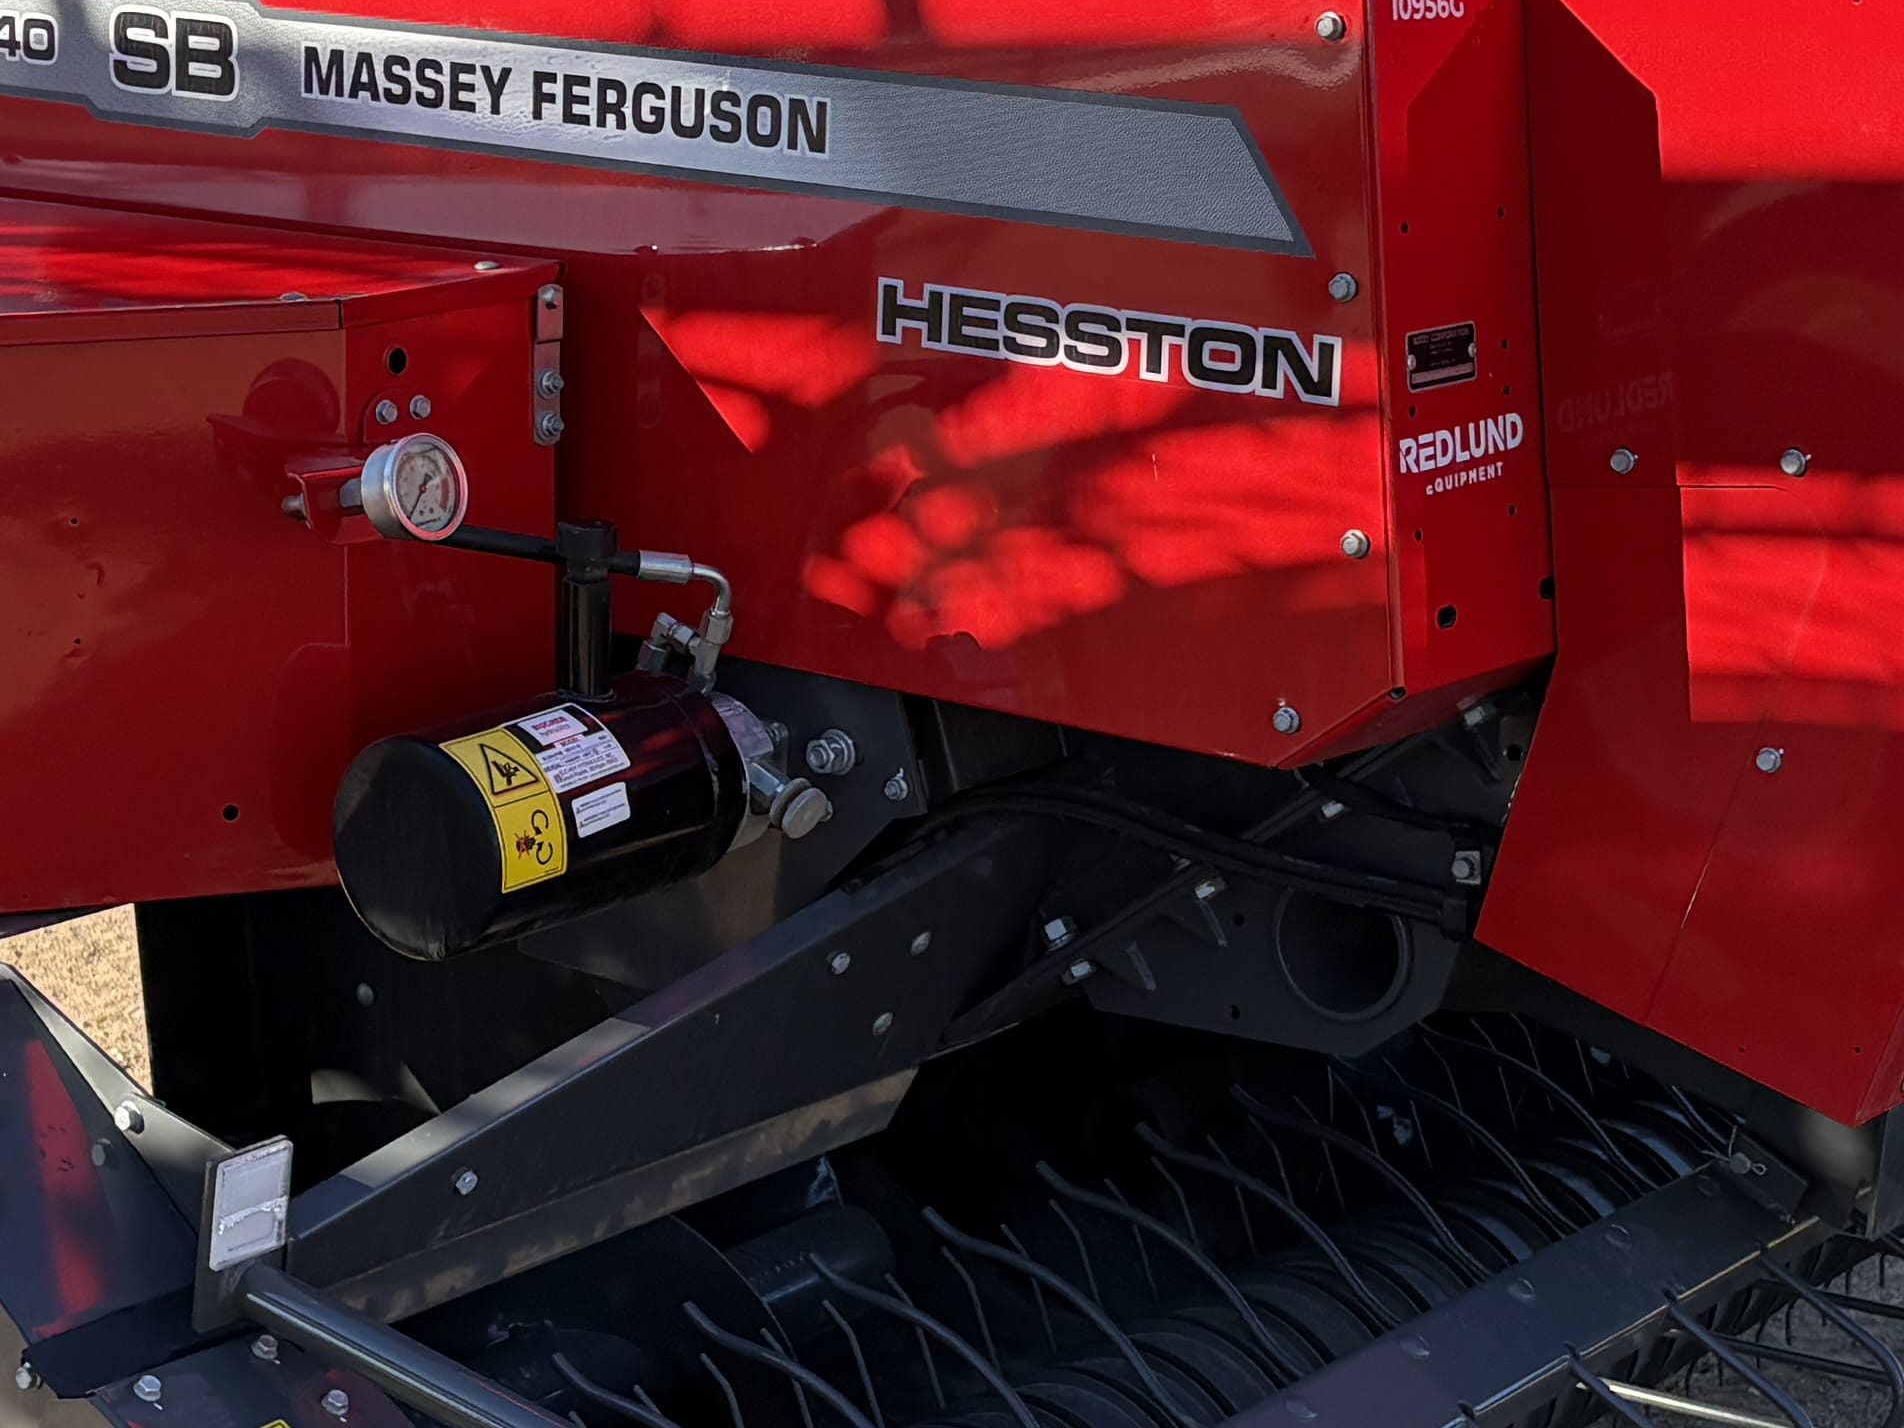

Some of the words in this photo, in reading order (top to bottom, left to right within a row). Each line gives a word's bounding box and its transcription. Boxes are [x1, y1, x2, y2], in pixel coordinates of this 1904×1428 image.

[110, 6, 238, 100] SB
[303, 46, 512, 116] MASSEY
[532, 70, 828, 154] FERGUSON
[878, 278, 1340, 405] HESSTON
[1399, 412, 1524, 474] REDLUND
